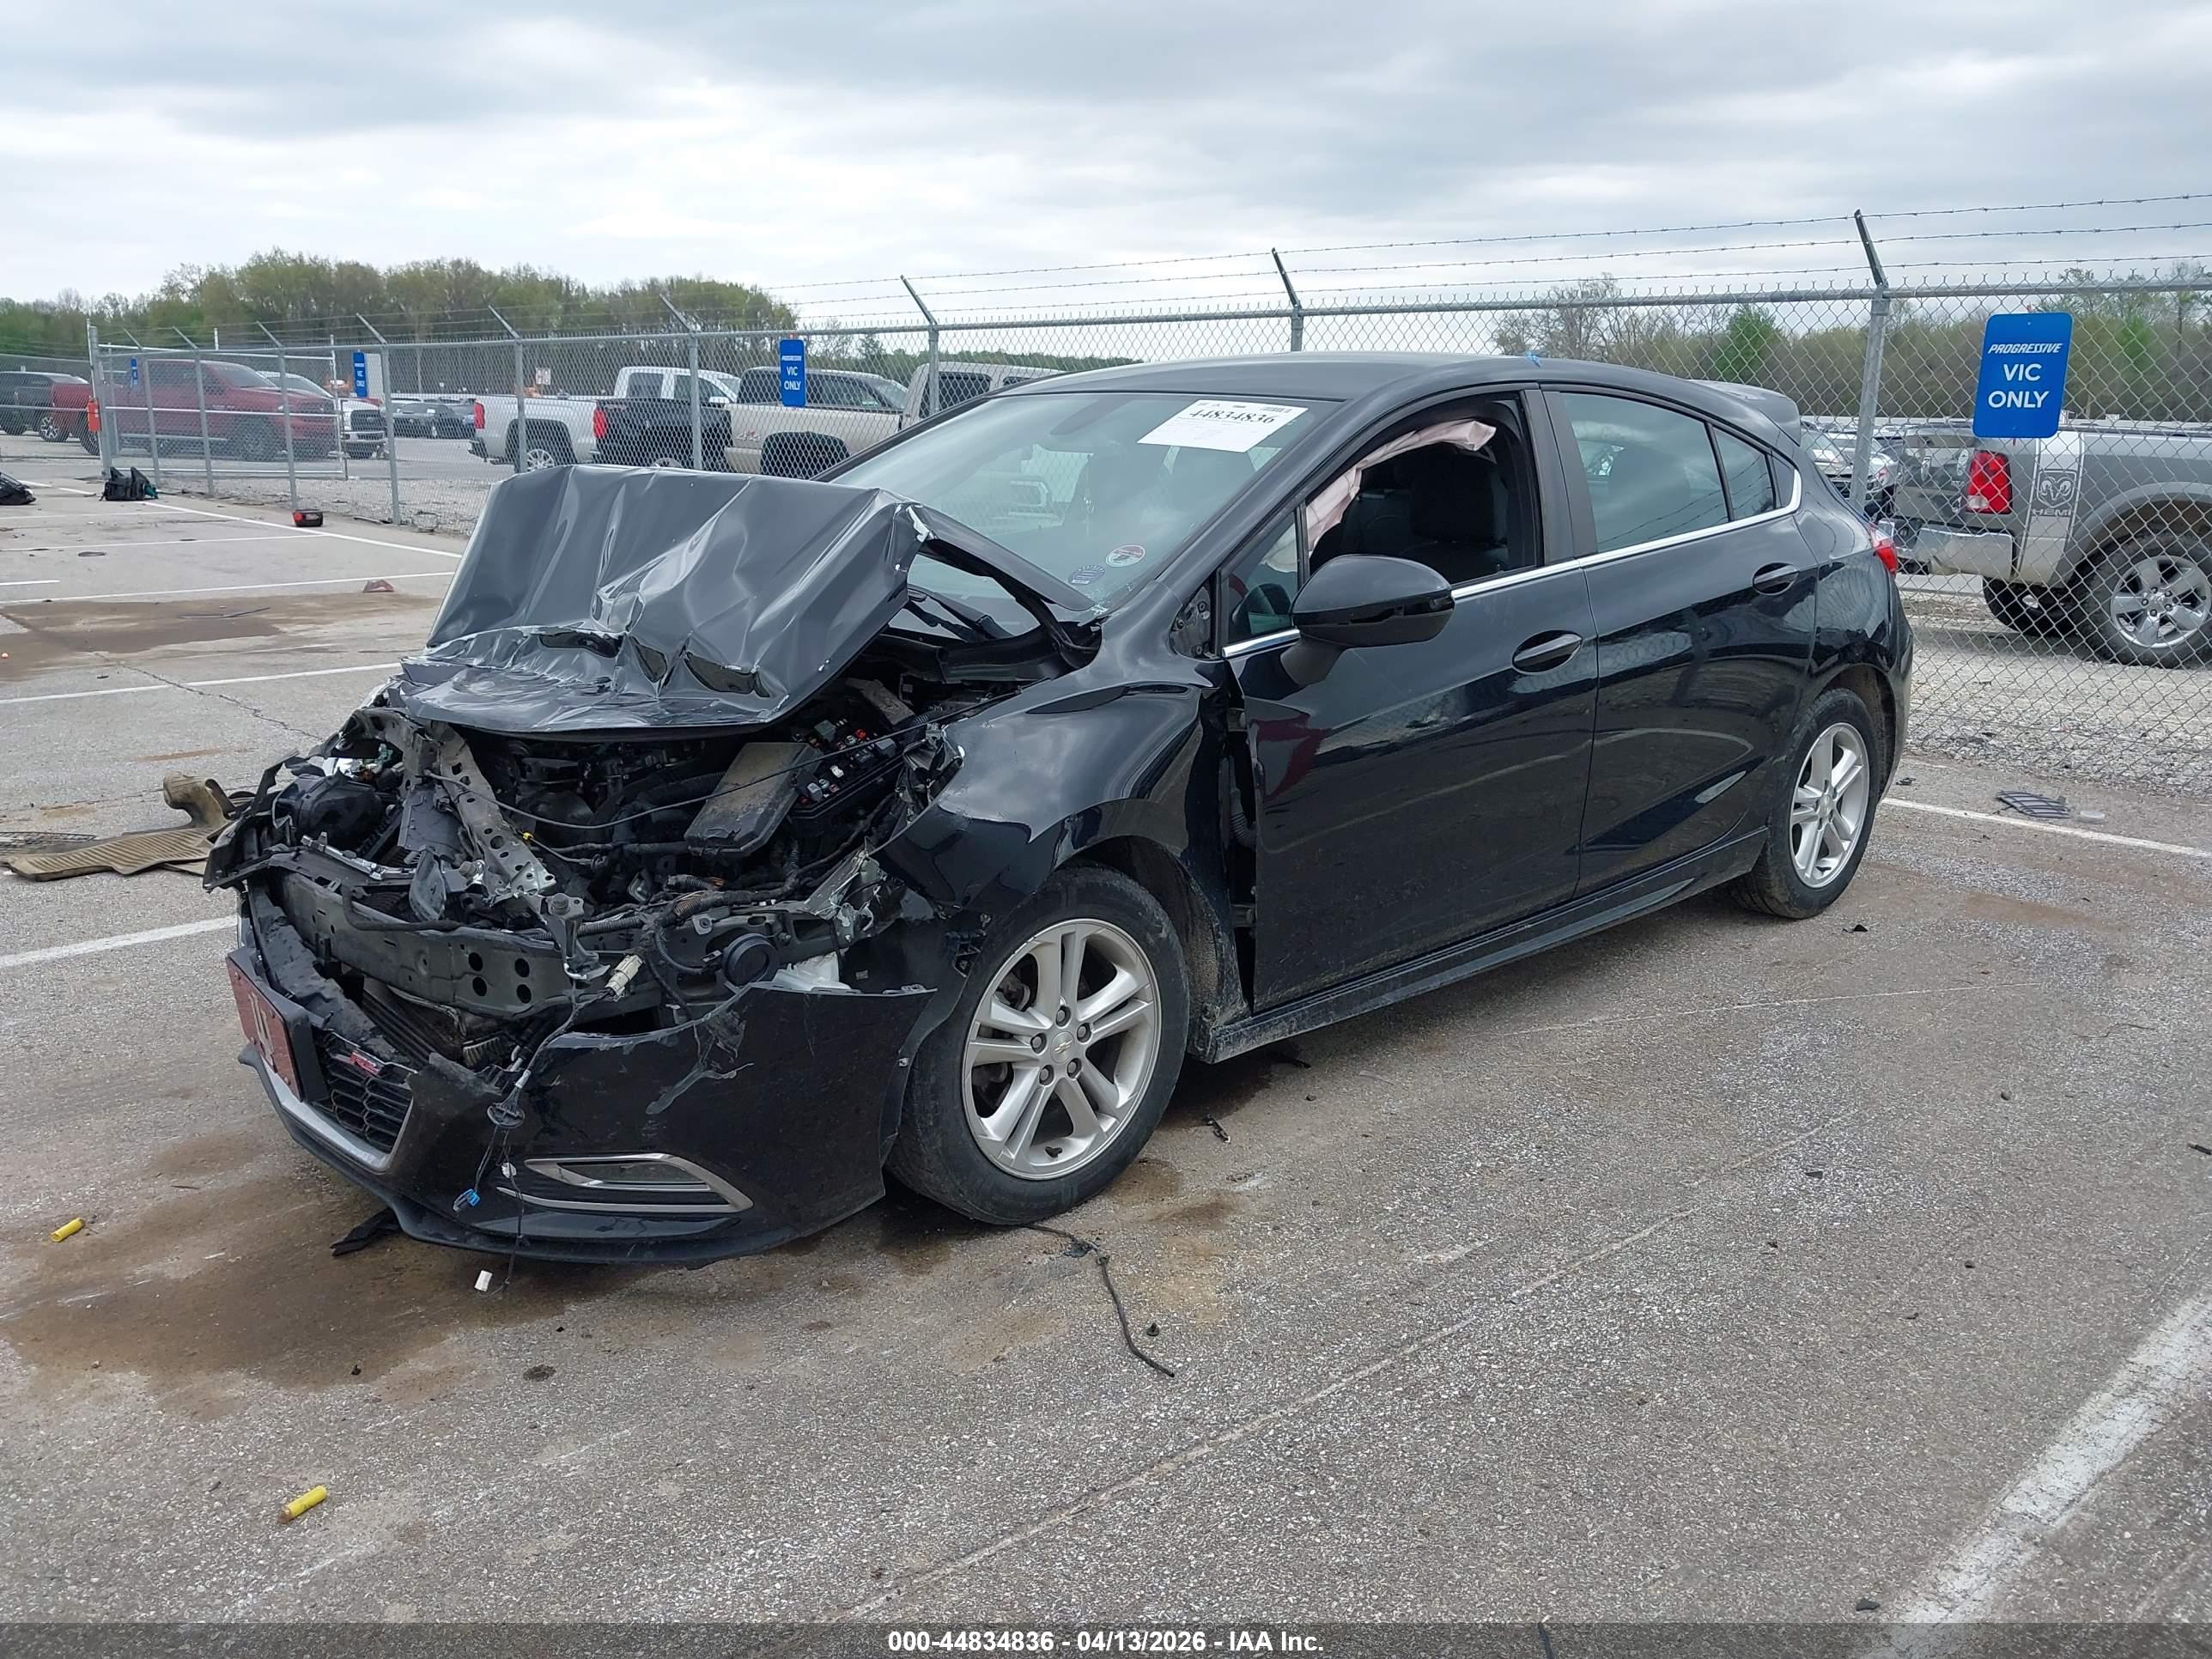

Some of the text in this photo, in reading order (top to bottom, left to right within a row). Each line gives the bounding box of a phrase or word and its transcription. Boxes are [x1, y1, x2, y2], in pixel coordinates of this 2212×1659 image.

[1988, 343, 2063, 354] PROGRESSIVE
[786, 365, 799, 376] VIC
[2002, 363, 2043, 381] VIC
[785, 380, 802, 391] ONLY
[1988, 390, 2050, 408] ONLY
[1189, 409, 1279, 424] 44834836
